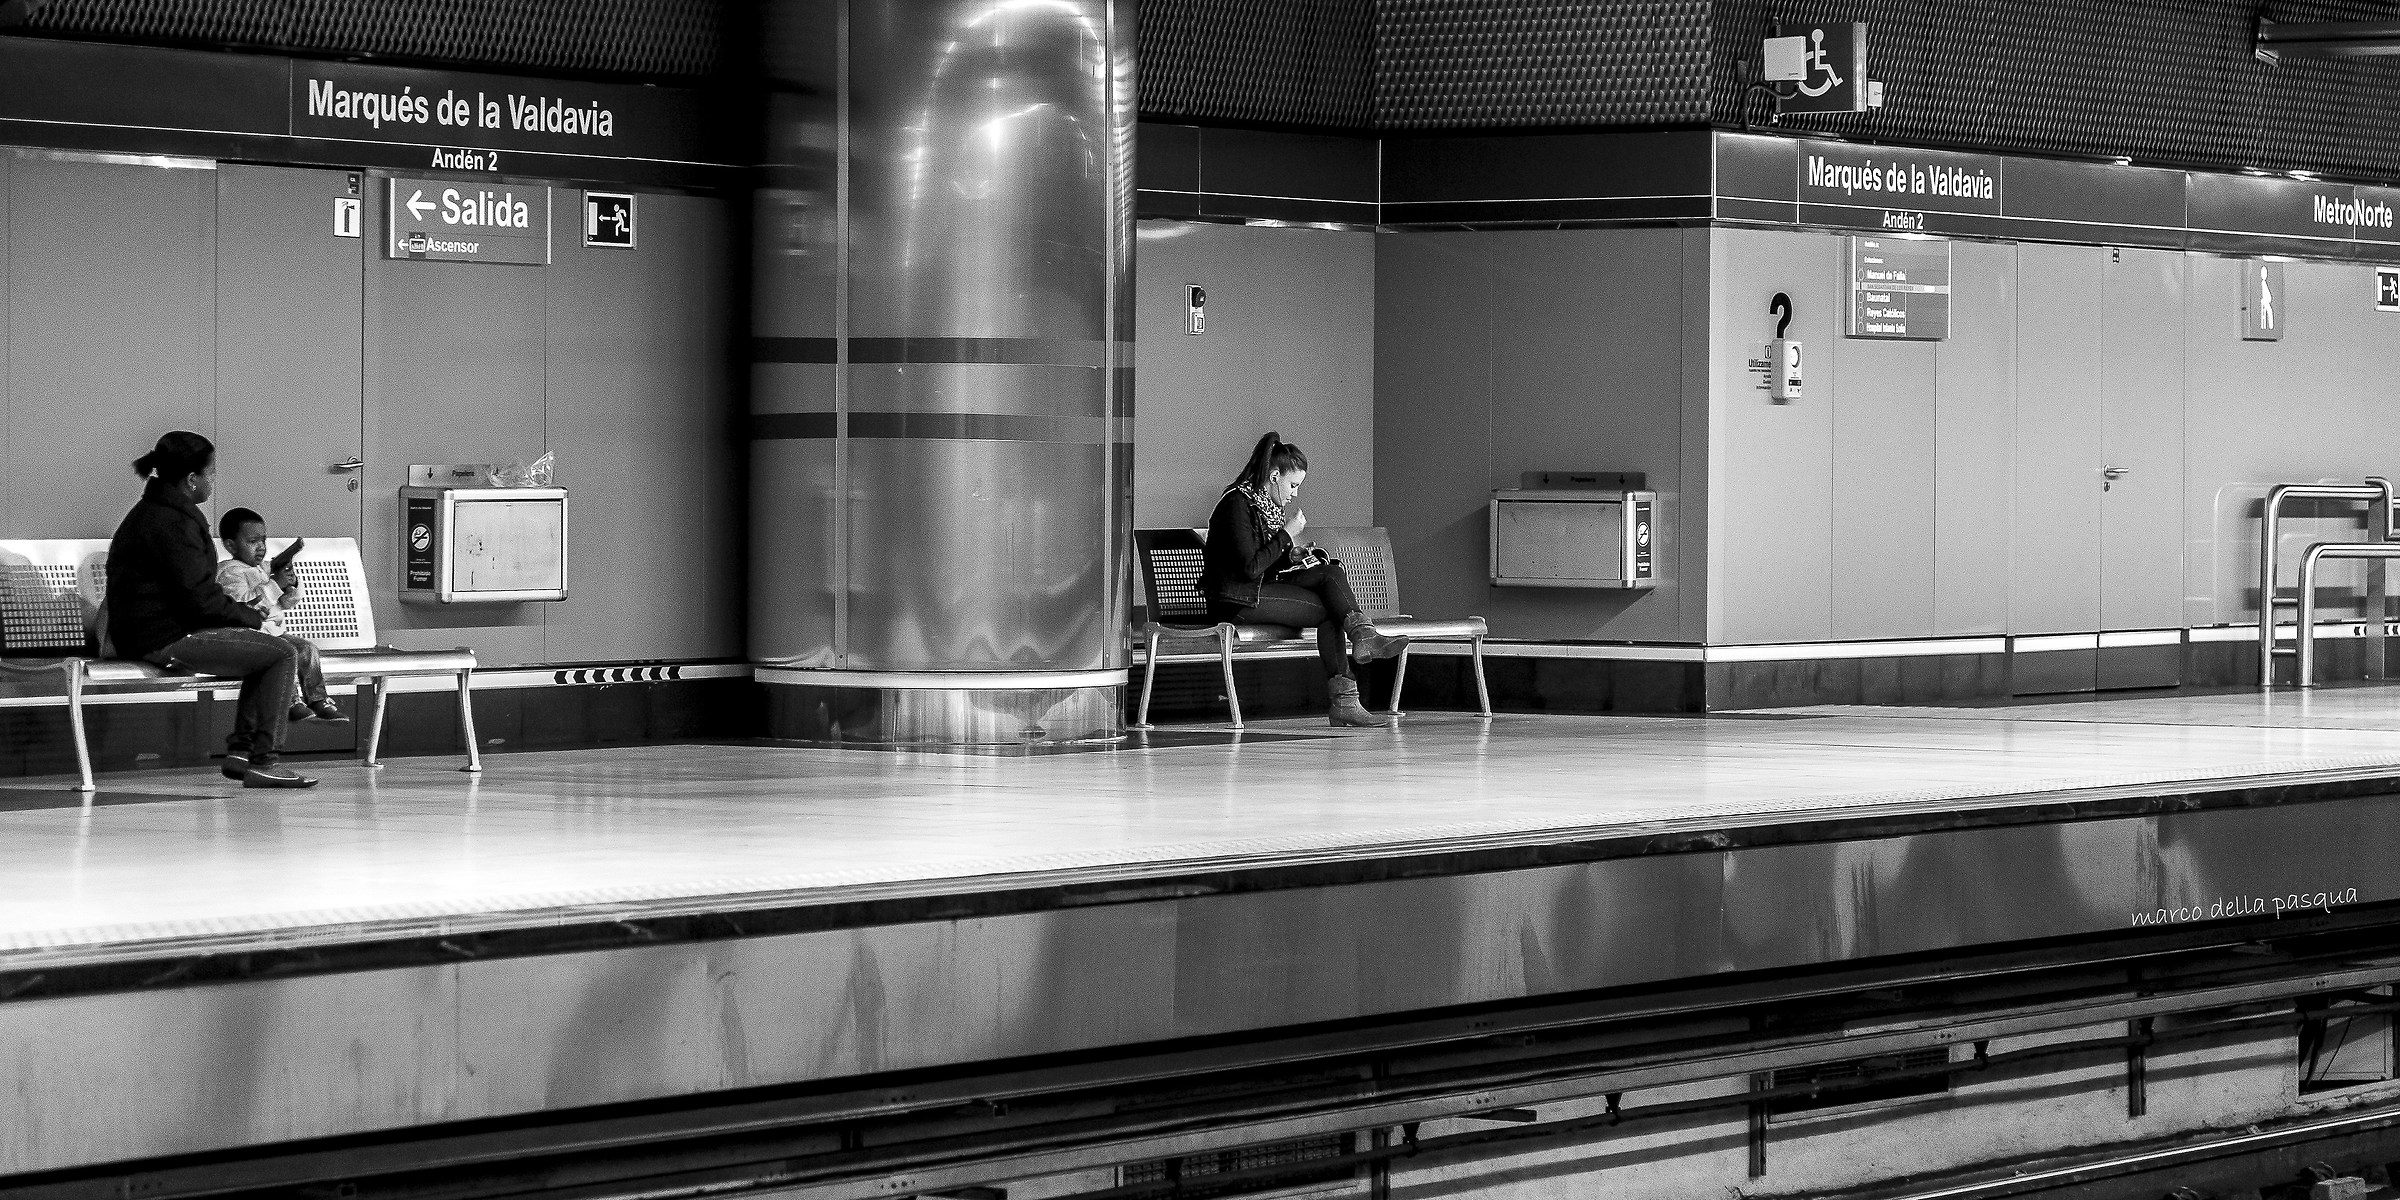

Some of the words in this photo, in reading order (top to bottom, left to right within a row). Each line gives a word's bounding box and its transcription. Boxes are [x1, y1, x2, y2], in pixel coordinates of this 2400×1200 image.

[308, 78, 429, 129] Marqués
[437, 89, 470, 127] de
[478, 92, 501, 129] la
[508, 94, 614, 137] Valdavia
[431, 148, 484, 171] Andén
[488, 151, 498, 171] 2
[1808, 155, 1882, 196] Marqués
[1886, 162, 1907, 193] de
[1911, 163, 1926, 195] la
[1929, 164, 1994, 200] Valdavia
[441, 188, 529, 228] Salida
[1882, 210, 1915, 229] Andén
[1917, 213, 1924, 229] 2
[2314, 194, 2393, 229] MetroNorte
[426, 237, 480, 254] Ascensor
